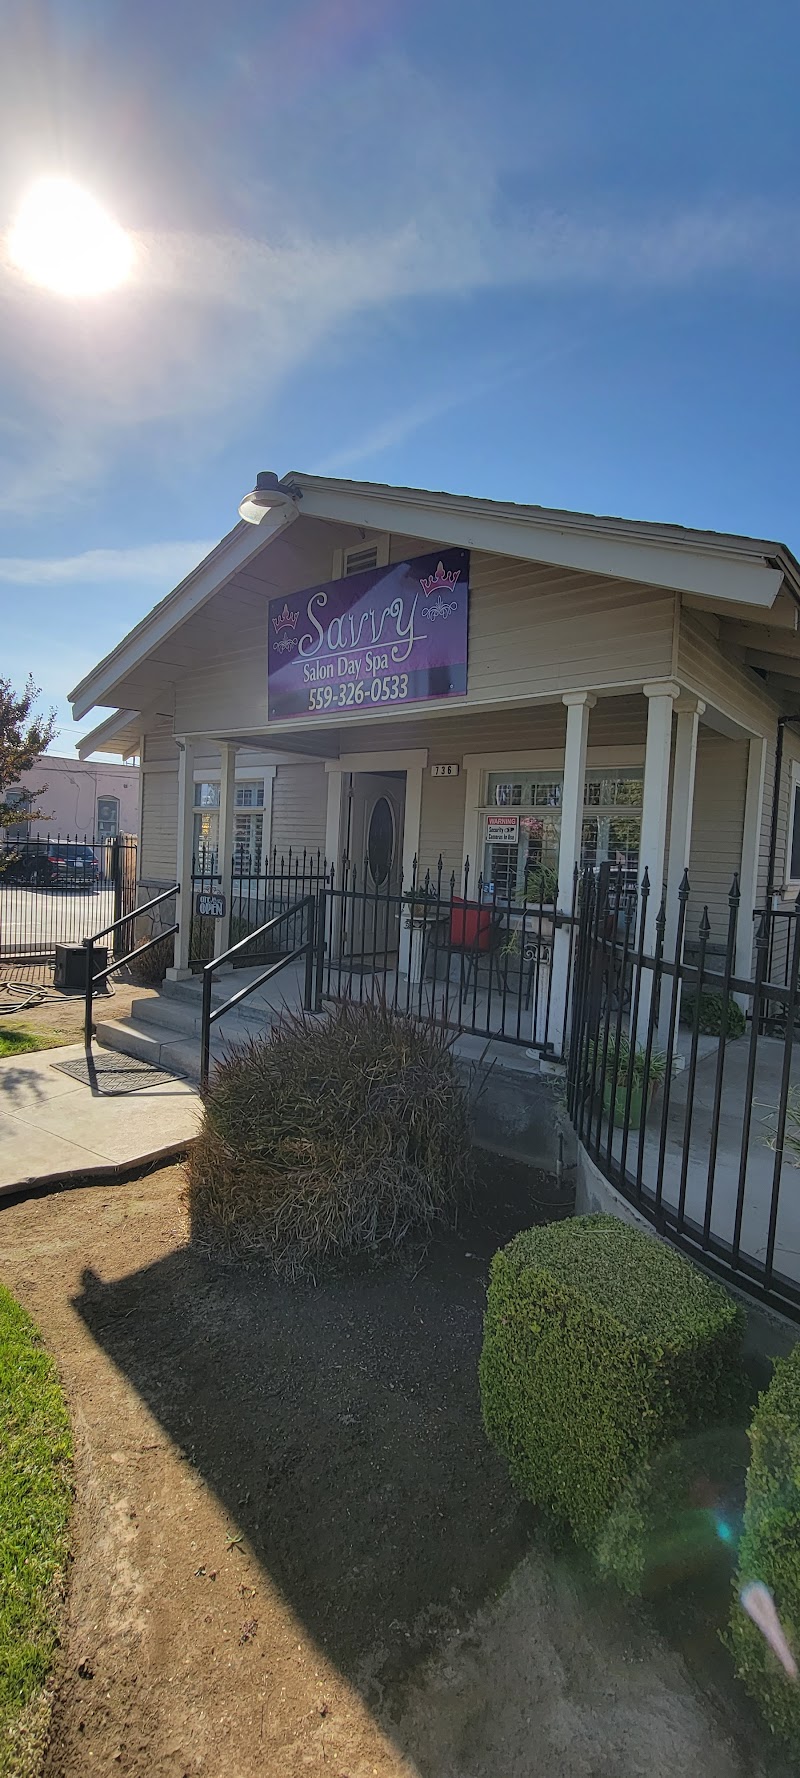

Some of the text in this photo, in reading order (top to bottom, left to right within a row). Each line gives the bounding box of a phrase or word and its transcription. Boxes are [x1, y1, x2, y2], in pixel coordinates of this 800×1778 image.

[298, 592, 419, 663] Savvy
[303, 651, 389, 682] Salon Day Spa
[308, 674, 409, 711] 559-326-0533
[435, 766, 452, 775] 736
[200, 903, 222, 915] OPEN
